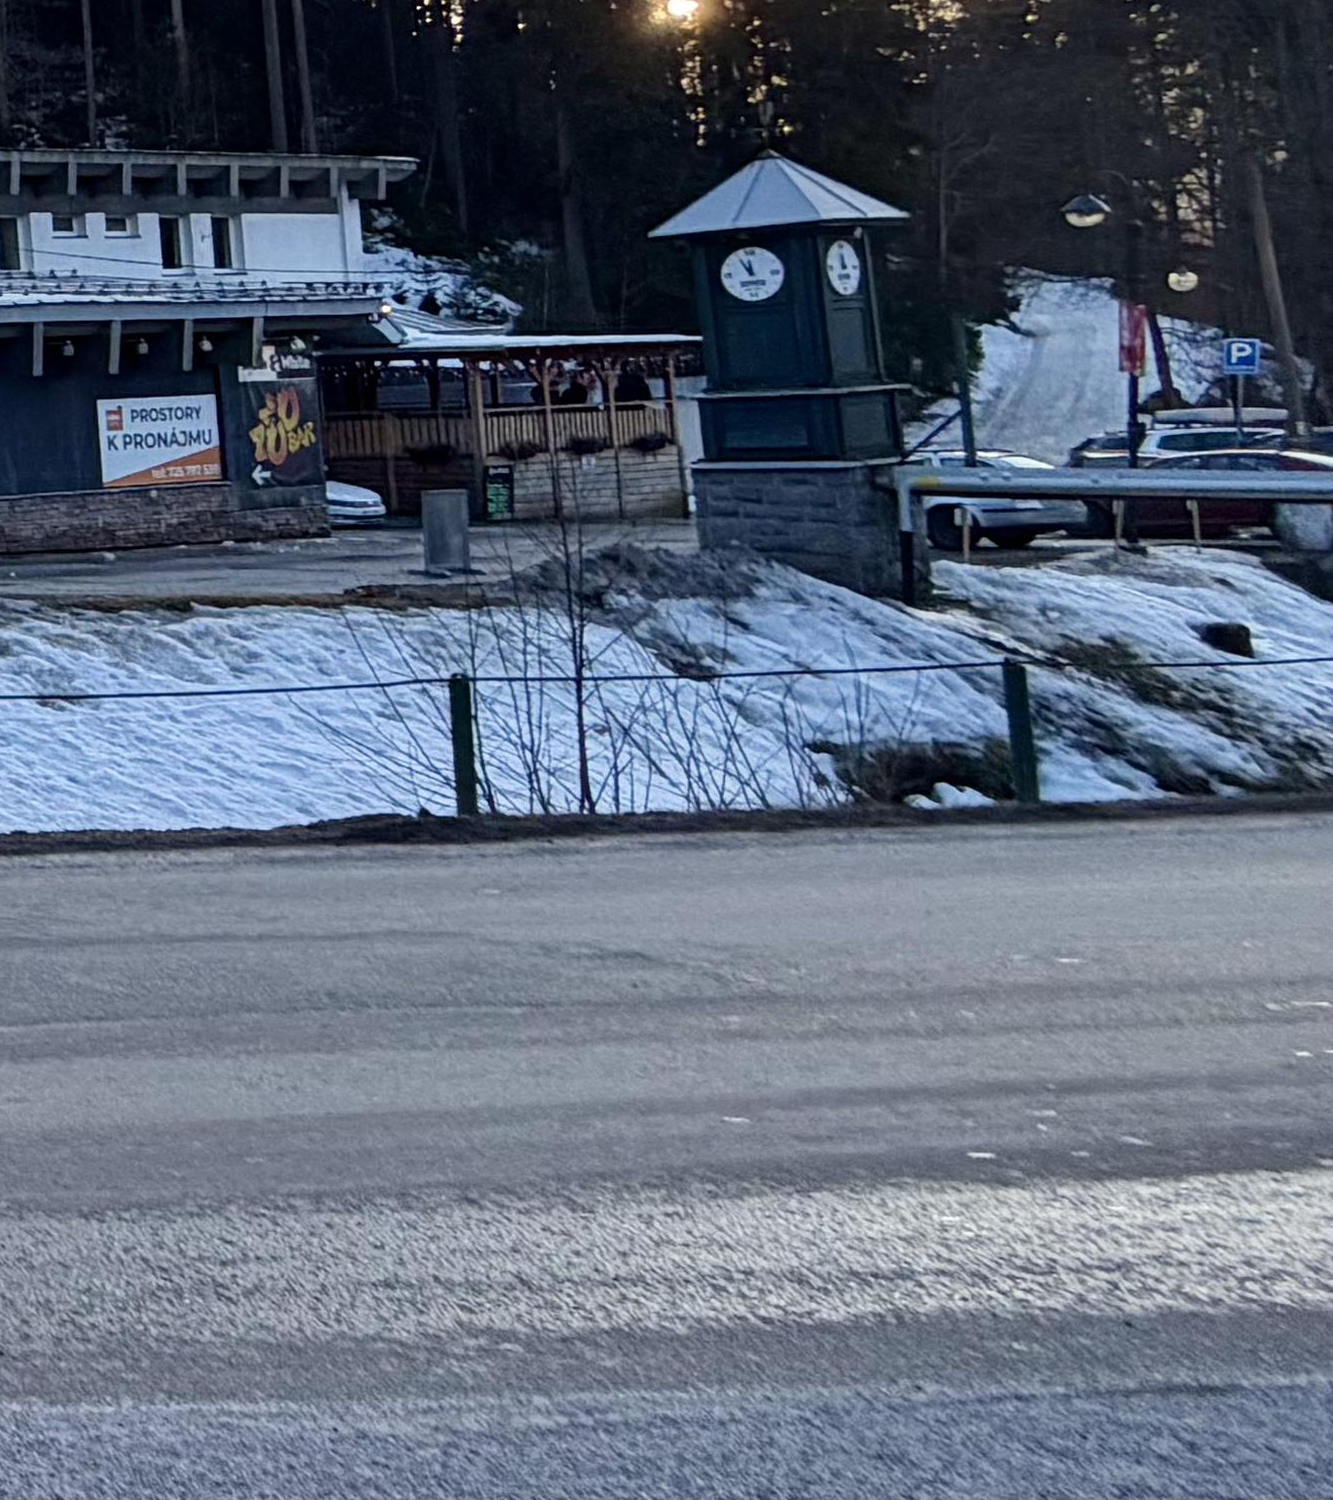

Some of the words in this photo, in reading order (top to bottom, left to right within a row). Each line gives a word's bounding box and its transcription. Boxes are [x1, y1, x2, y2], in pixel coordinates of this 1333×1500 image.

[1229, 342, 1254, 364] P
[130, 405, 202, 423] PROSTORY
[107, 435, 119, 451] K
[123, 427, 212, 451] PRONÁJMU
